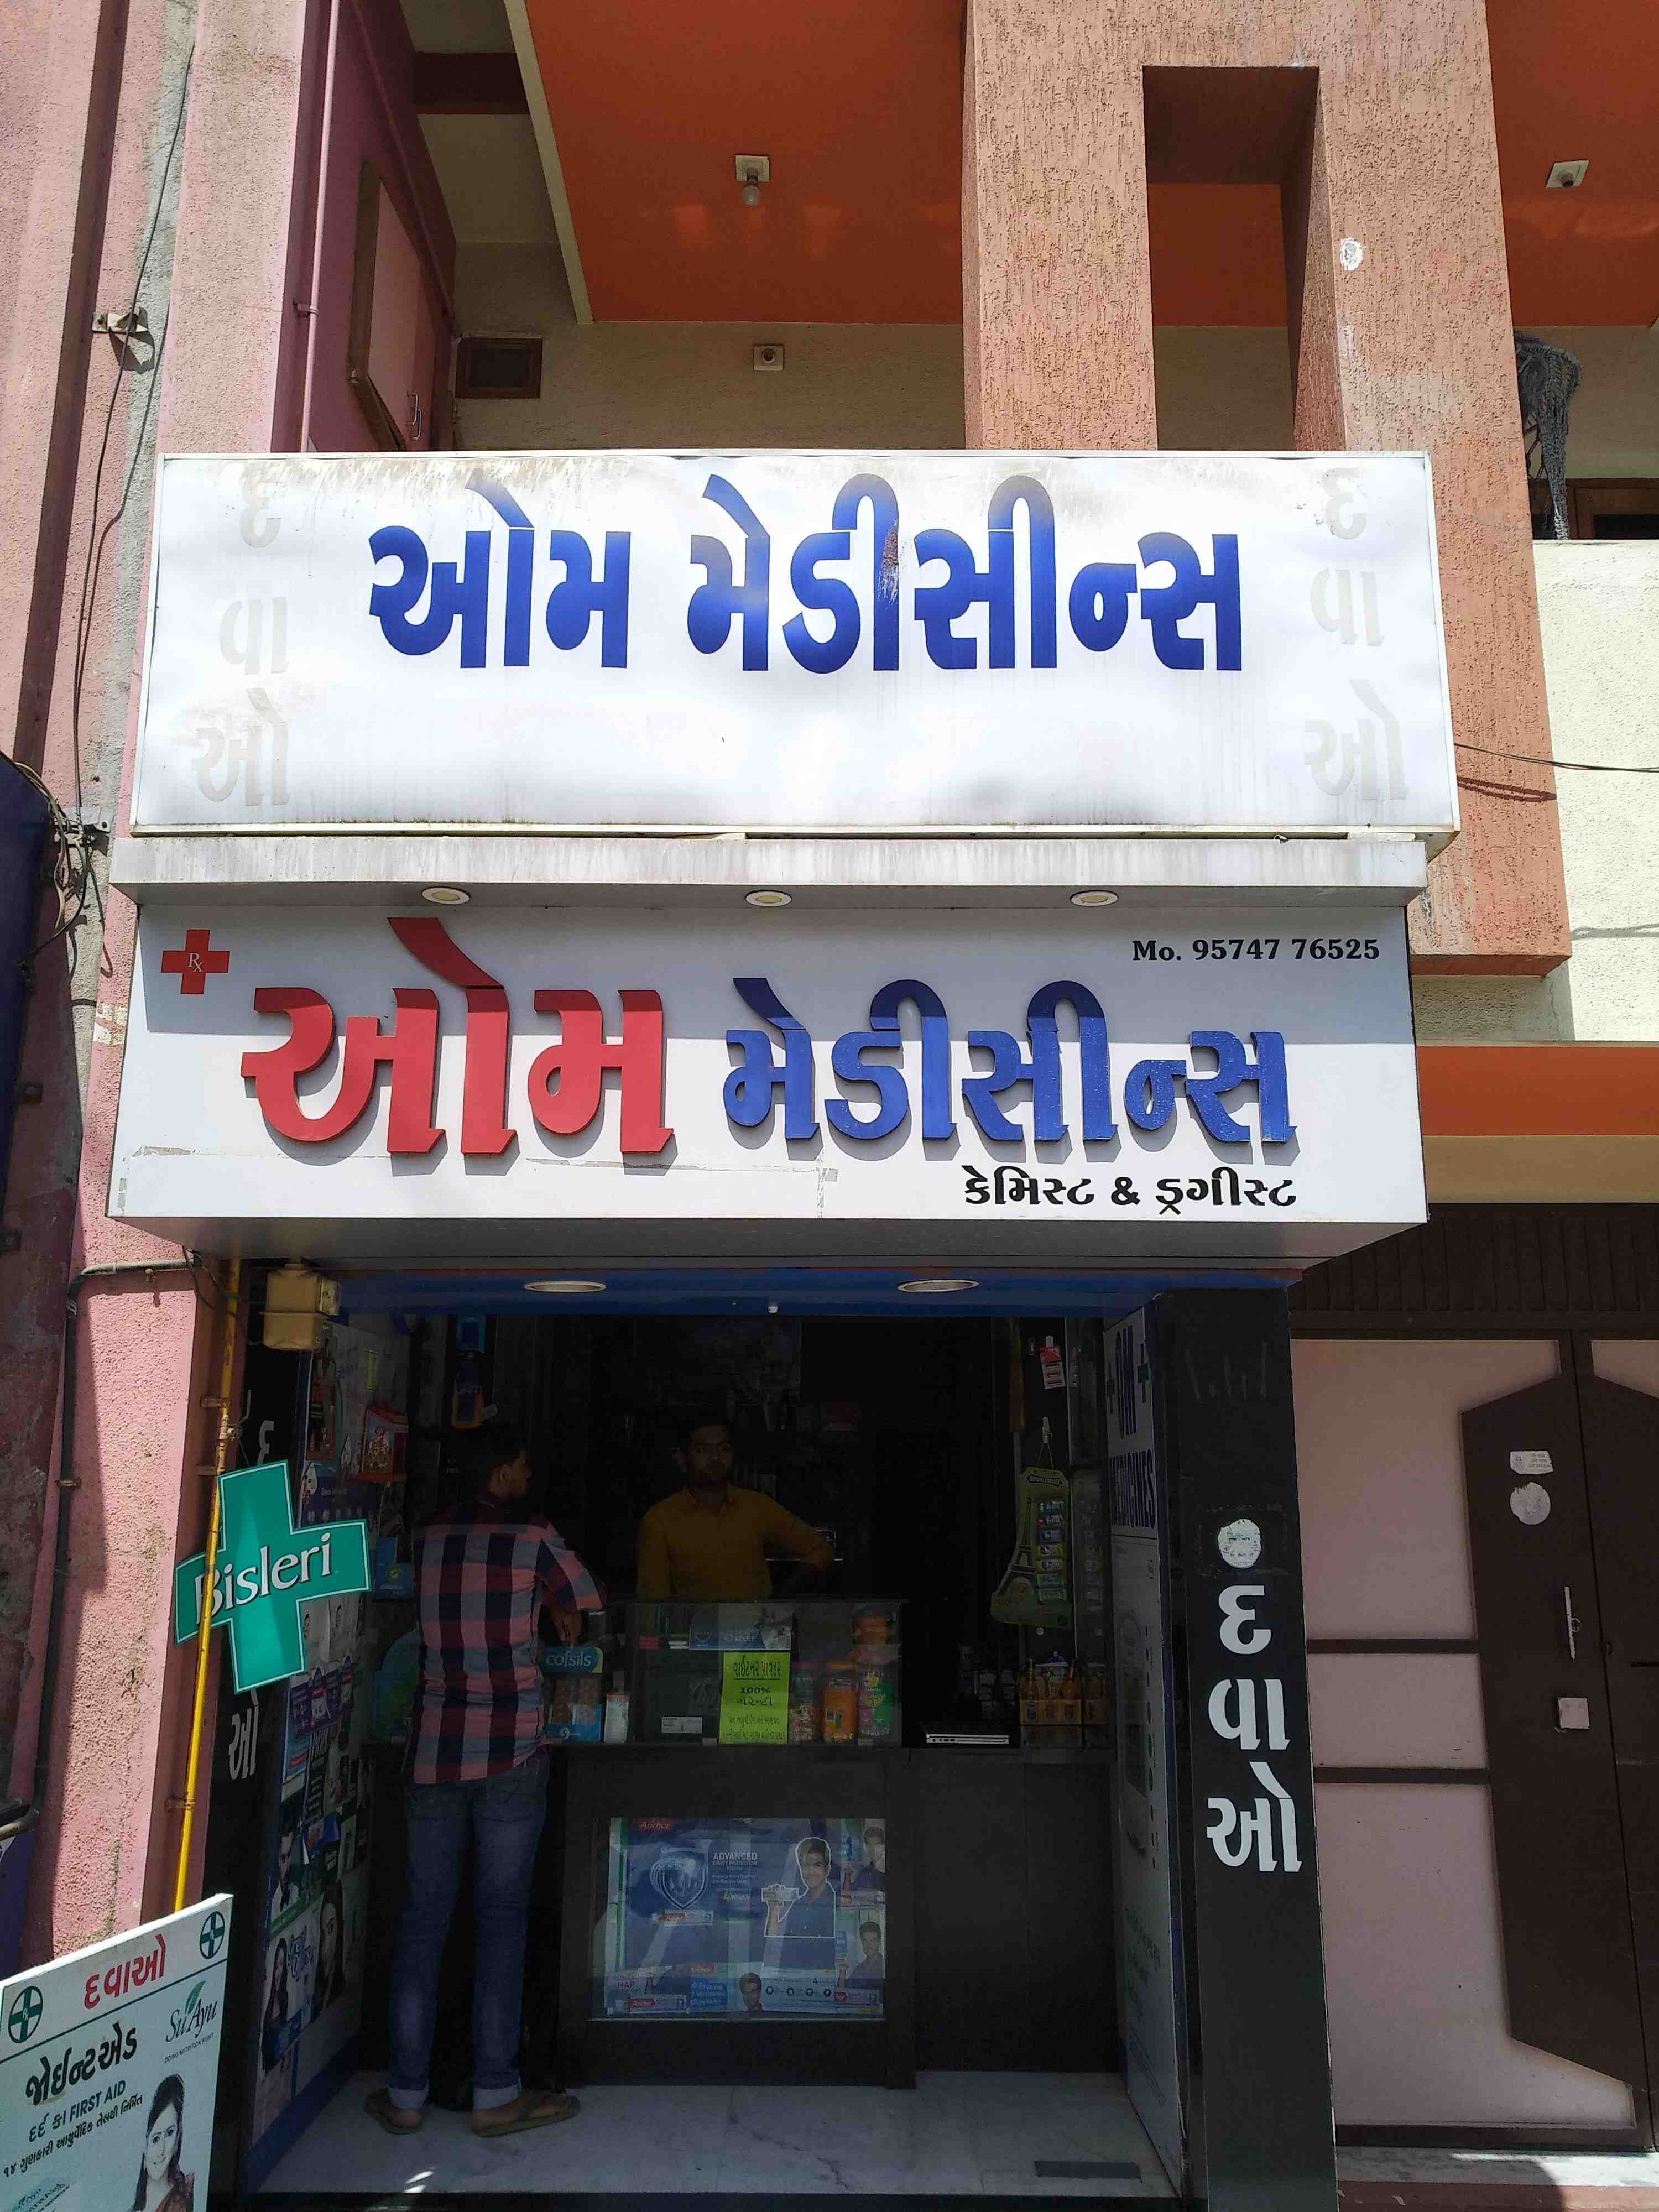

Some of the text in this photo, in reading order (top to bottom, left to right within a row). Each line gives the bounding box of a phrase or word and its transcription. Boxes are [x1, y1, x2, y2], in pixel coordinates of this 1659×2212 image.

[368, 474, 1242, 674] ઓમ મેડીસીન્સ
[1132, 938, 1380, 961] Mo. 95747 76525
[241, 917, 1297, 1155] ઓમ મેડીસીન્સ
[961, 1165, 1095, 1205] કેમિસ્ટ
[1111, 1177, 1140, 1206] &
[194, 1532, 331, 1625] Bisleri
[546, 1652, 593, 1668] cofsils
[712, 1853, 758, 1861] ADVANCED
[85, 1934, 166, 2009] દવાઓ
[69, 2091, 102, 2122] FIRST
[104, 2080, 126, 2103] AID
